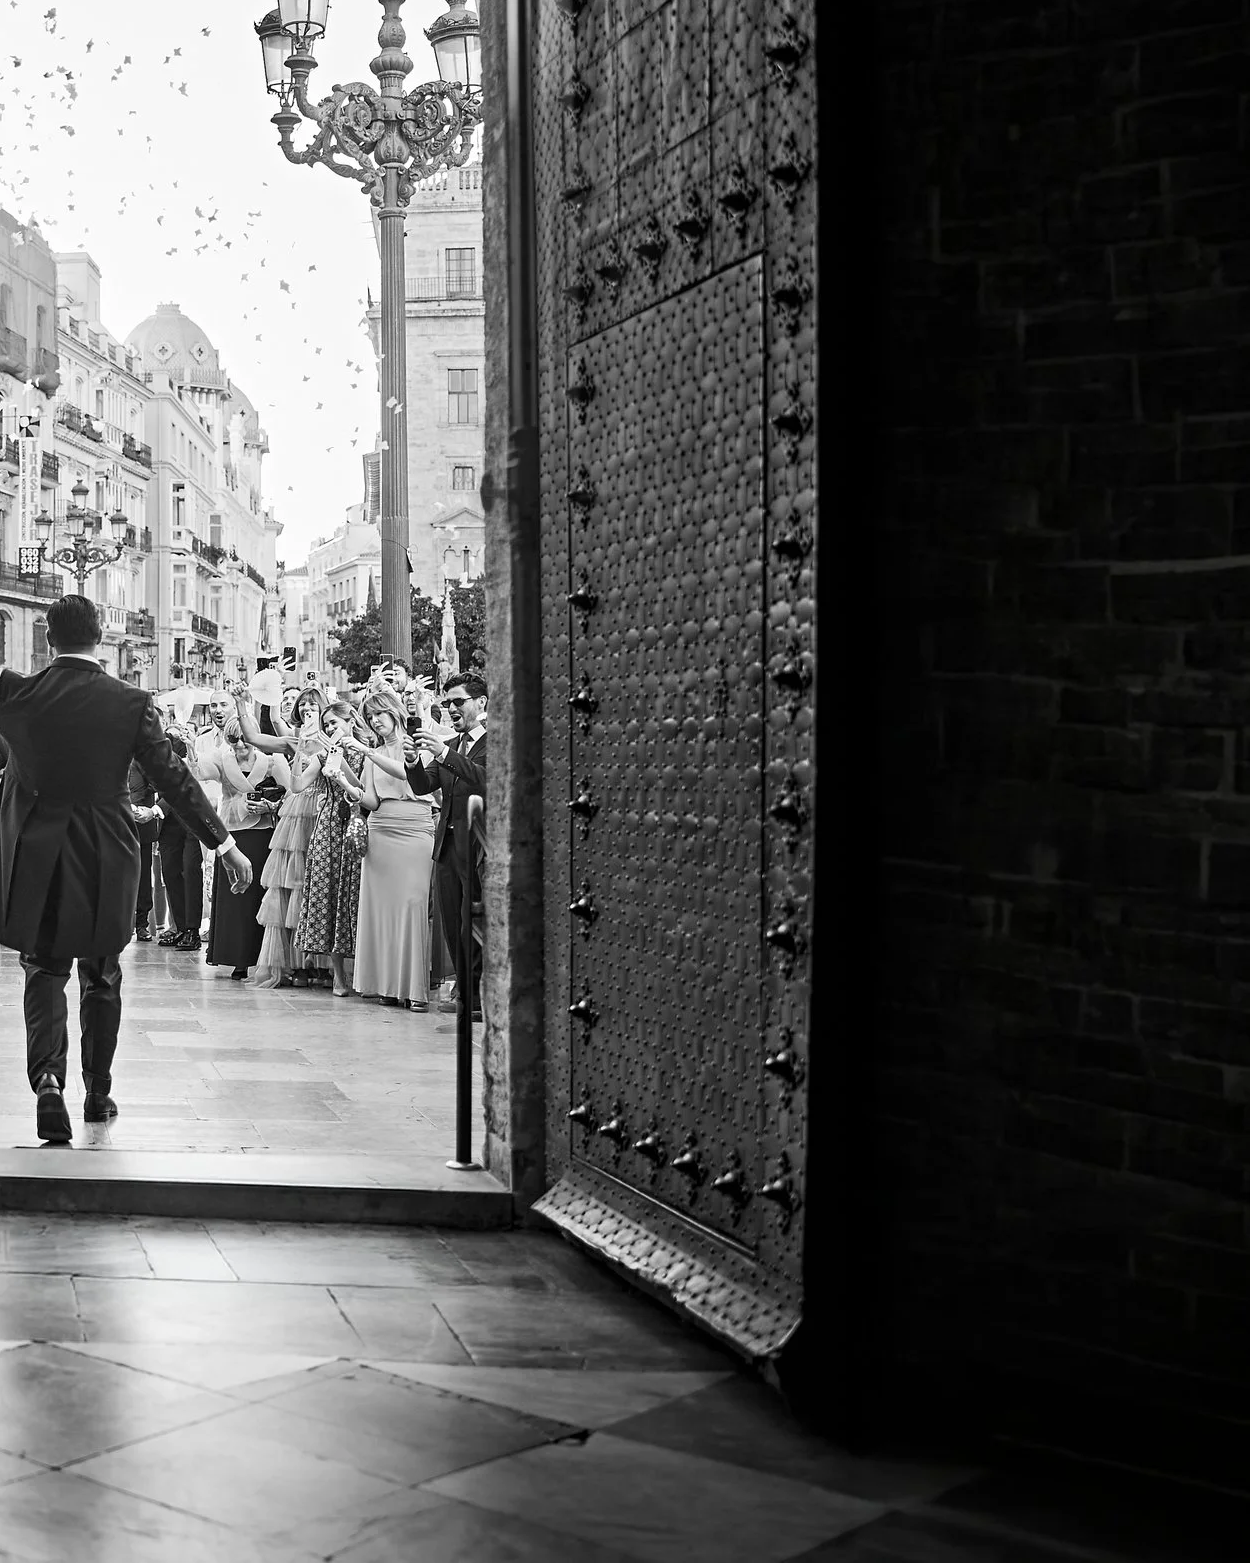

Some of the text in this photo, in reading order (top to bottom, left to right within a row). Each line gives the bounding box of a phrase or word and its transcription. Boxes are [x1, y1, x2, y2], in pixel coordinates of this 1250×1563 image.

[21, 548, 39, 557] 960
[21, 556, 39, 565] 032
[21, 564, 39, 574] 346
